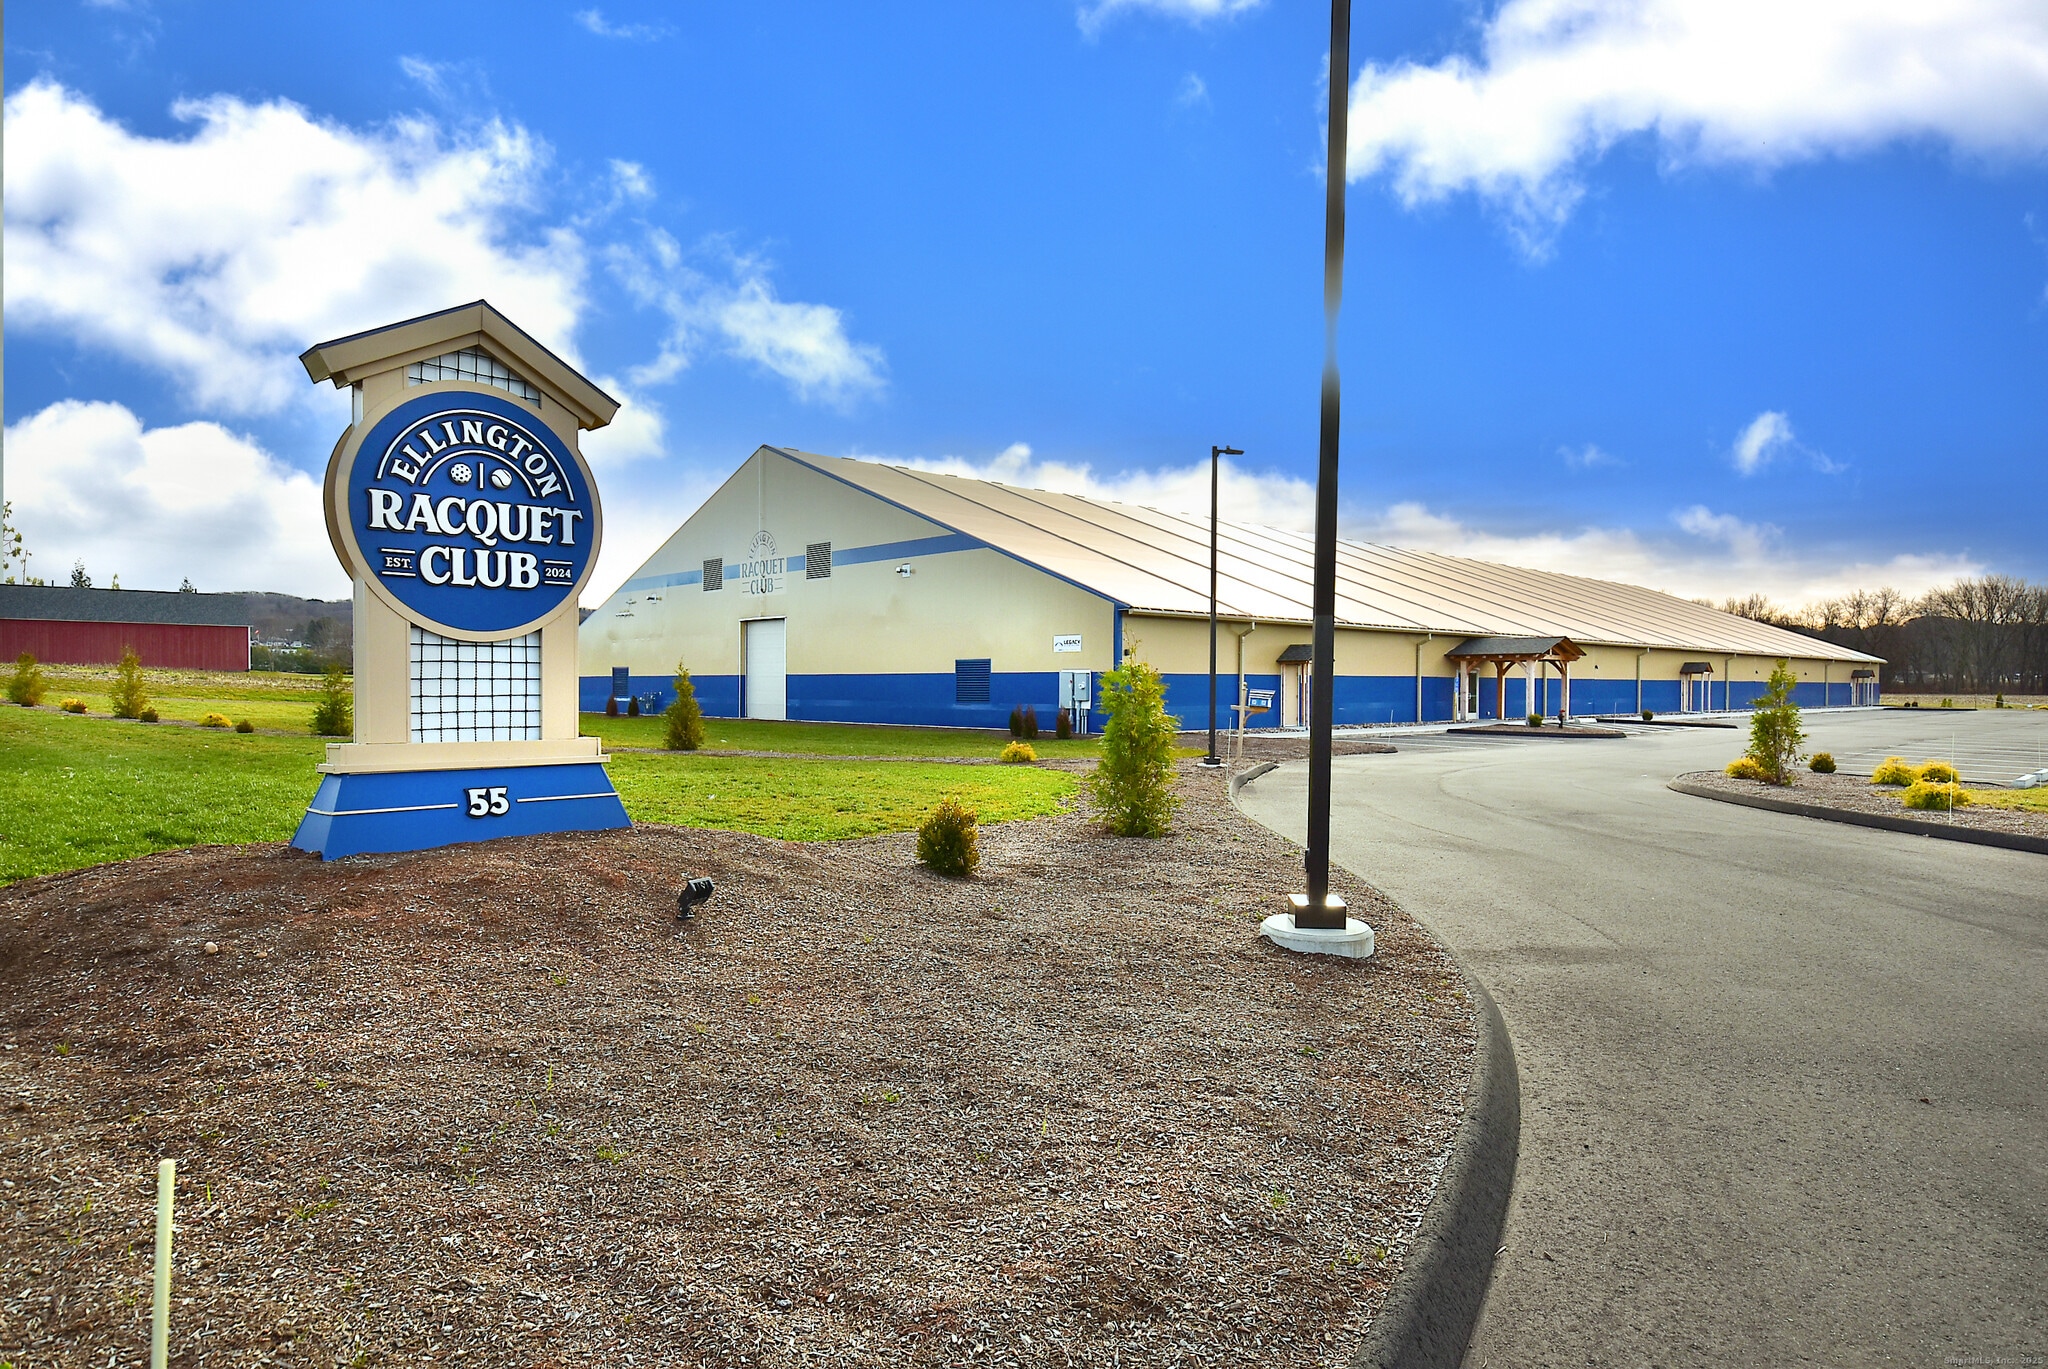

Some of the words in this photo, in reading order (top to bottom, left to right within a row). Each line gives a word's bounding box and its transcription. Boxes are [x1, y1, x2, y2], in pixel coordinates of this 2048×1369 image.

[390, 420, 562, 497] ELLINGTON
[368, 488, 583, 545] RACQUET
[386, 557, 412, 568] EST.
[419, 546, 540, 589] CLUB
[545, 567, 571, 579] 2024
[741, 558, 784, 578] RACQUET
[750, 578, 774, 594] CLUB
[467, 786, 510, 816] 55
